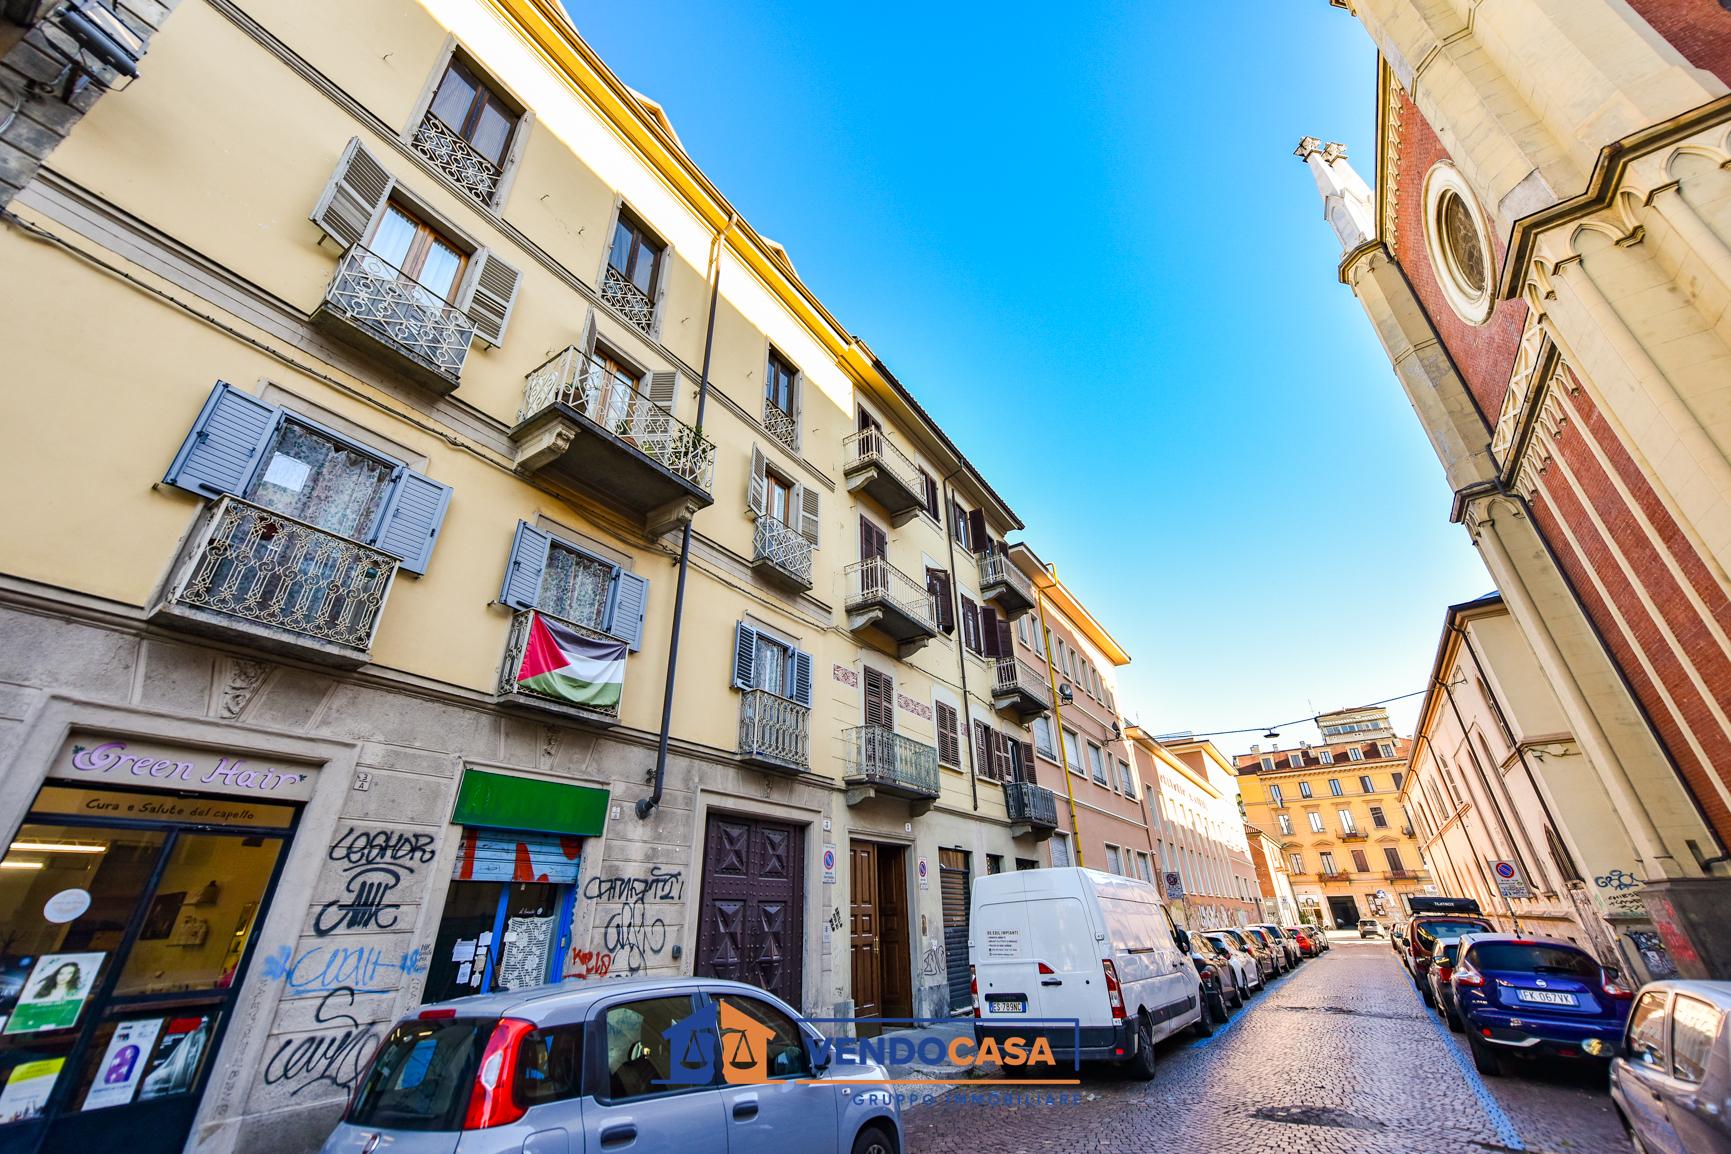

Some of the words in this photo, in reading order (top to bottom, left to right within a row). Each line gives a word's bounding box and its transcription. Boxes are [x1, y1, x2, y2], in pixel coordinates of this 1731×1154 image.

[72, 742, 195, 781] Green
[200, 756, 300, 790] Hair
[86, 799, 119, 811] Cura
[138, 802, 184, 816] Salute
[190, 807, 209, 818] del
[213, 809, 255, 821] capello
[1523, 990, 1535, 1001] FK
[1539, 991, 1570, 1004] 067VK
[993, 1002, 1001, 1011] ES
